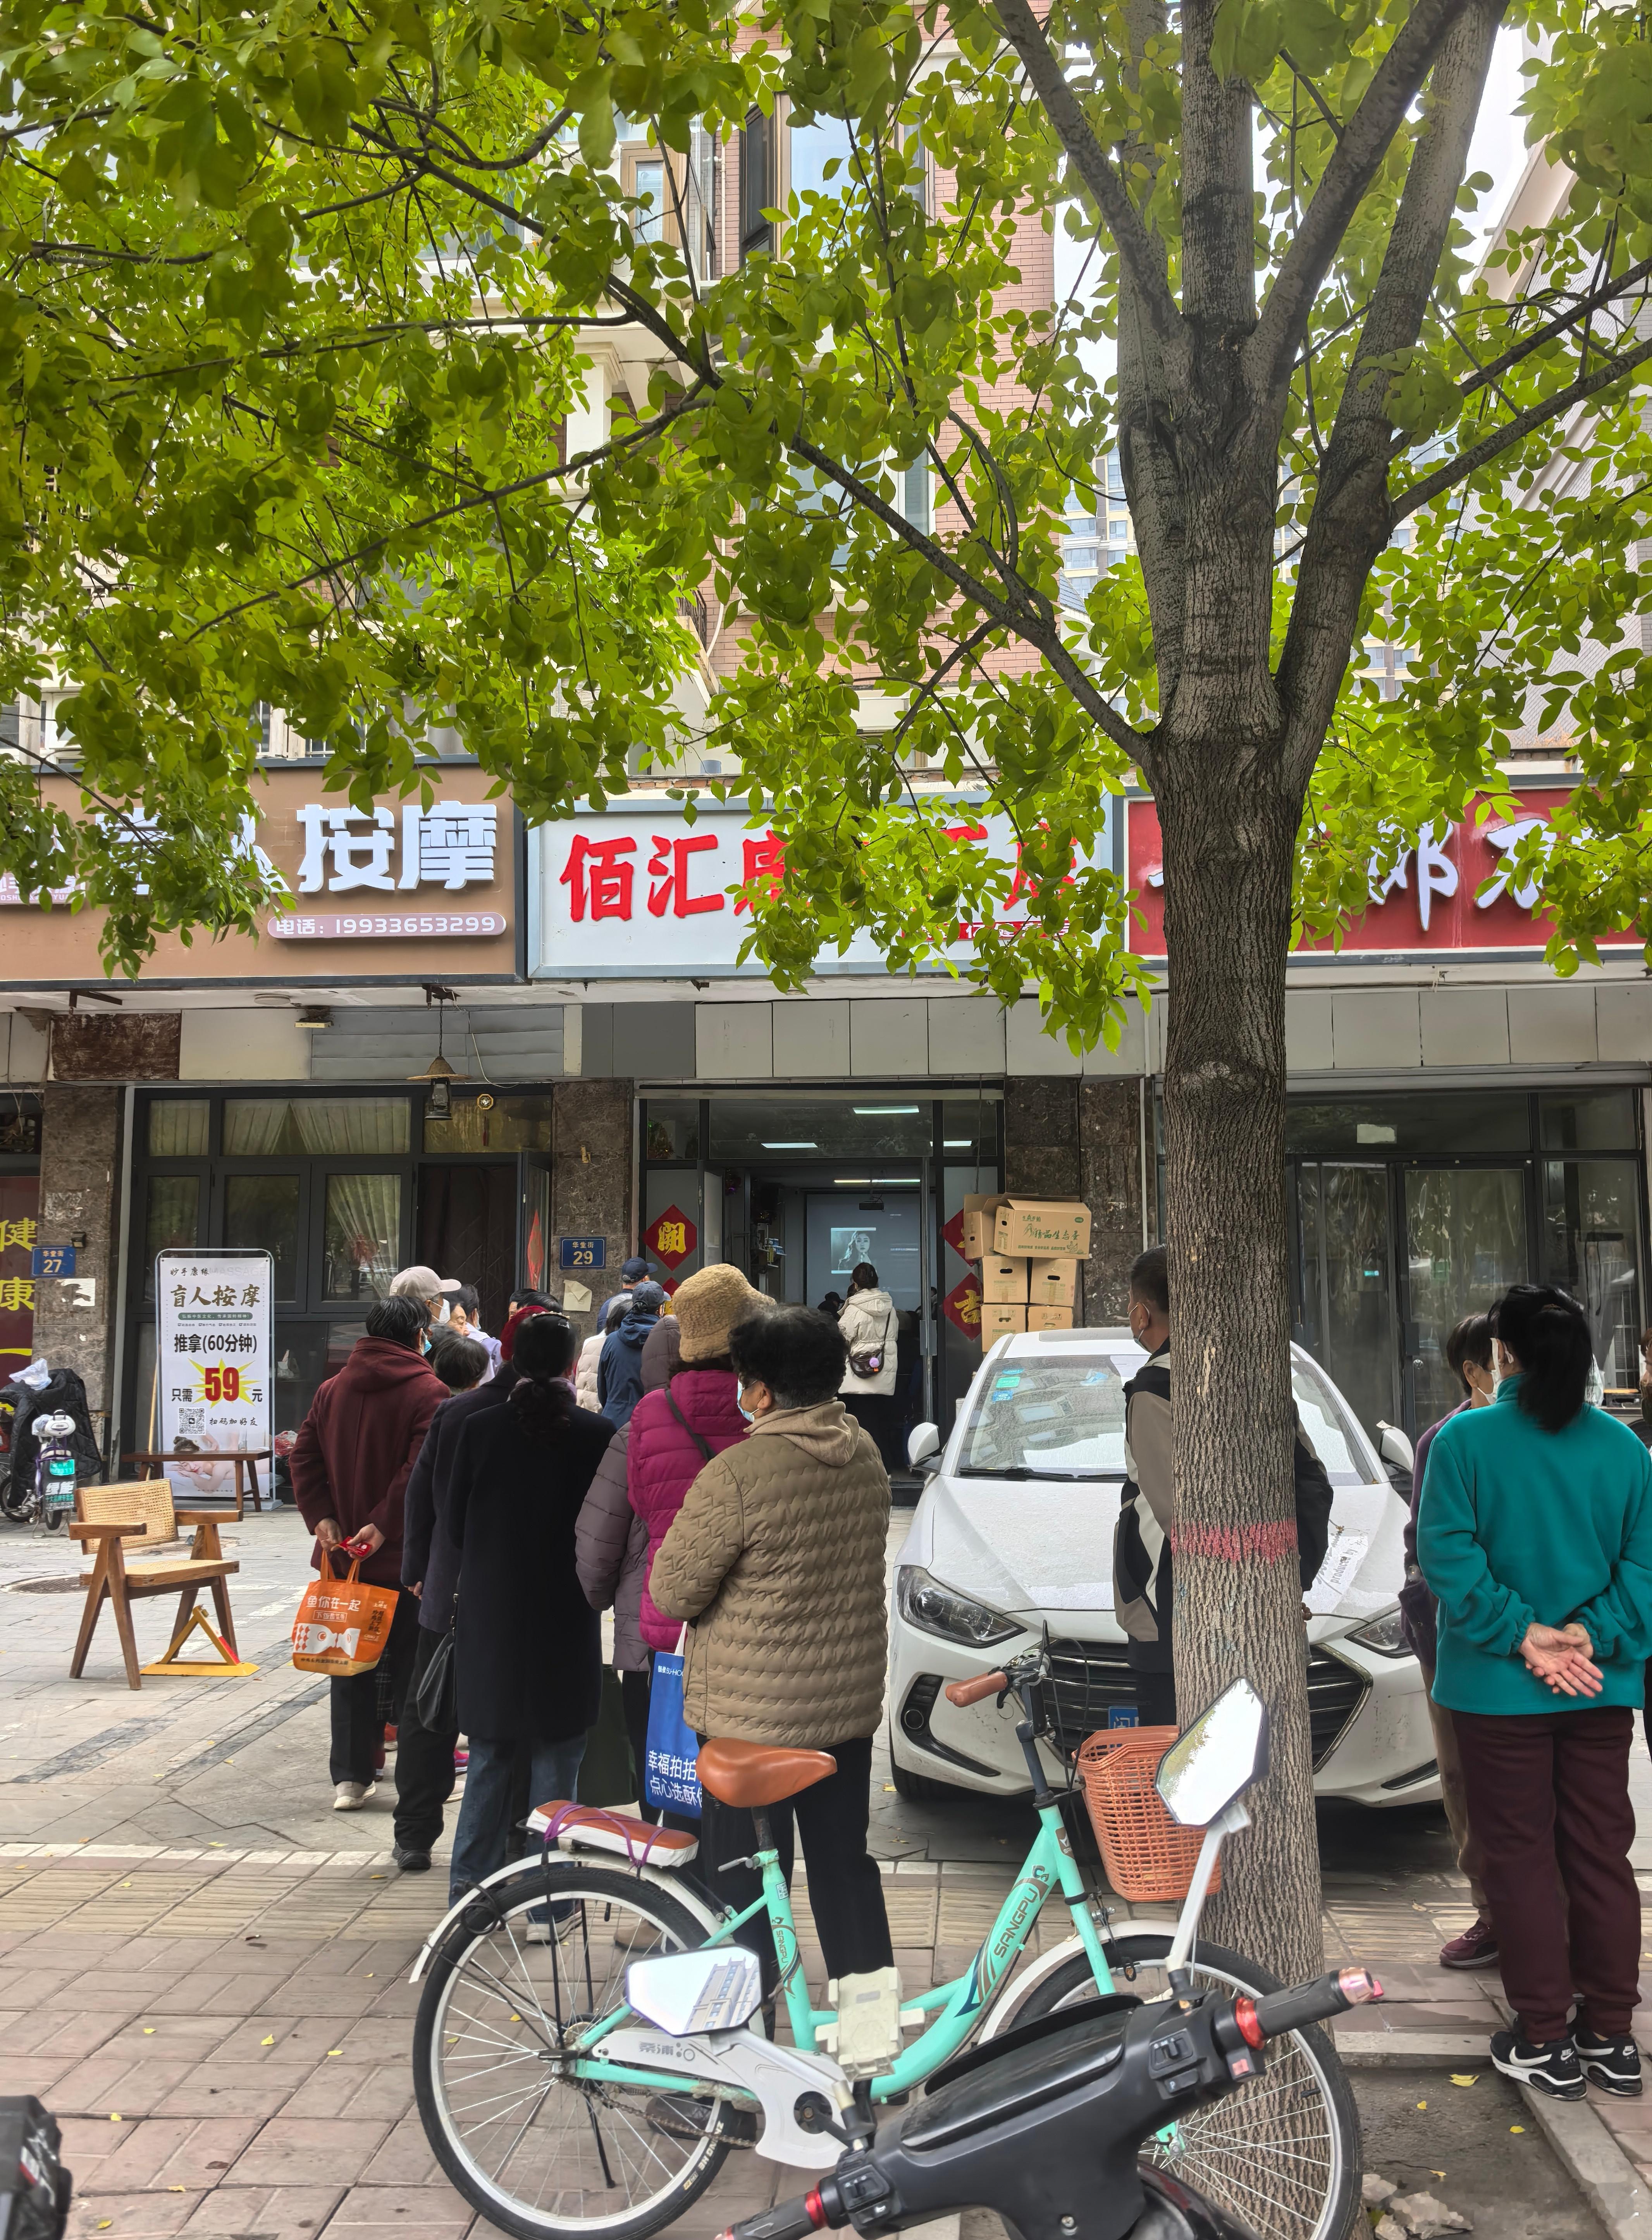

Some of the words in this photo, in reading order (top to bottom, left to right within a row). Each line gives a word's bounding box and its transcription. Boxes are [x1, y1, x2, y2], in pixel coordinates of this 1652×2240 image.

[43, 1259, 62, 1273] 27
[573, 1251, 593, 1265] 29
[170, 1284, 260, 1307] 盲人按摩
[174, 1333, 257, 1353] 推拿(60分钟)
[171, 1388, 193, 1402] 只需
[205, 1367, 239, 1402] 59
[251, 1389, 263, 1402] 元
[209, 1417, 258, 1426] 扫码加好友
[306, 1595, 361, 1612] 鱼你在一起
[648, 1750, 697, 1782] 幸福拍拍
[993, 1887, 1038, 1958] SANGPU
[776, 1930, 788, 1963] SANGPU
[1562, 2048, 1572, 2056] NIKE
